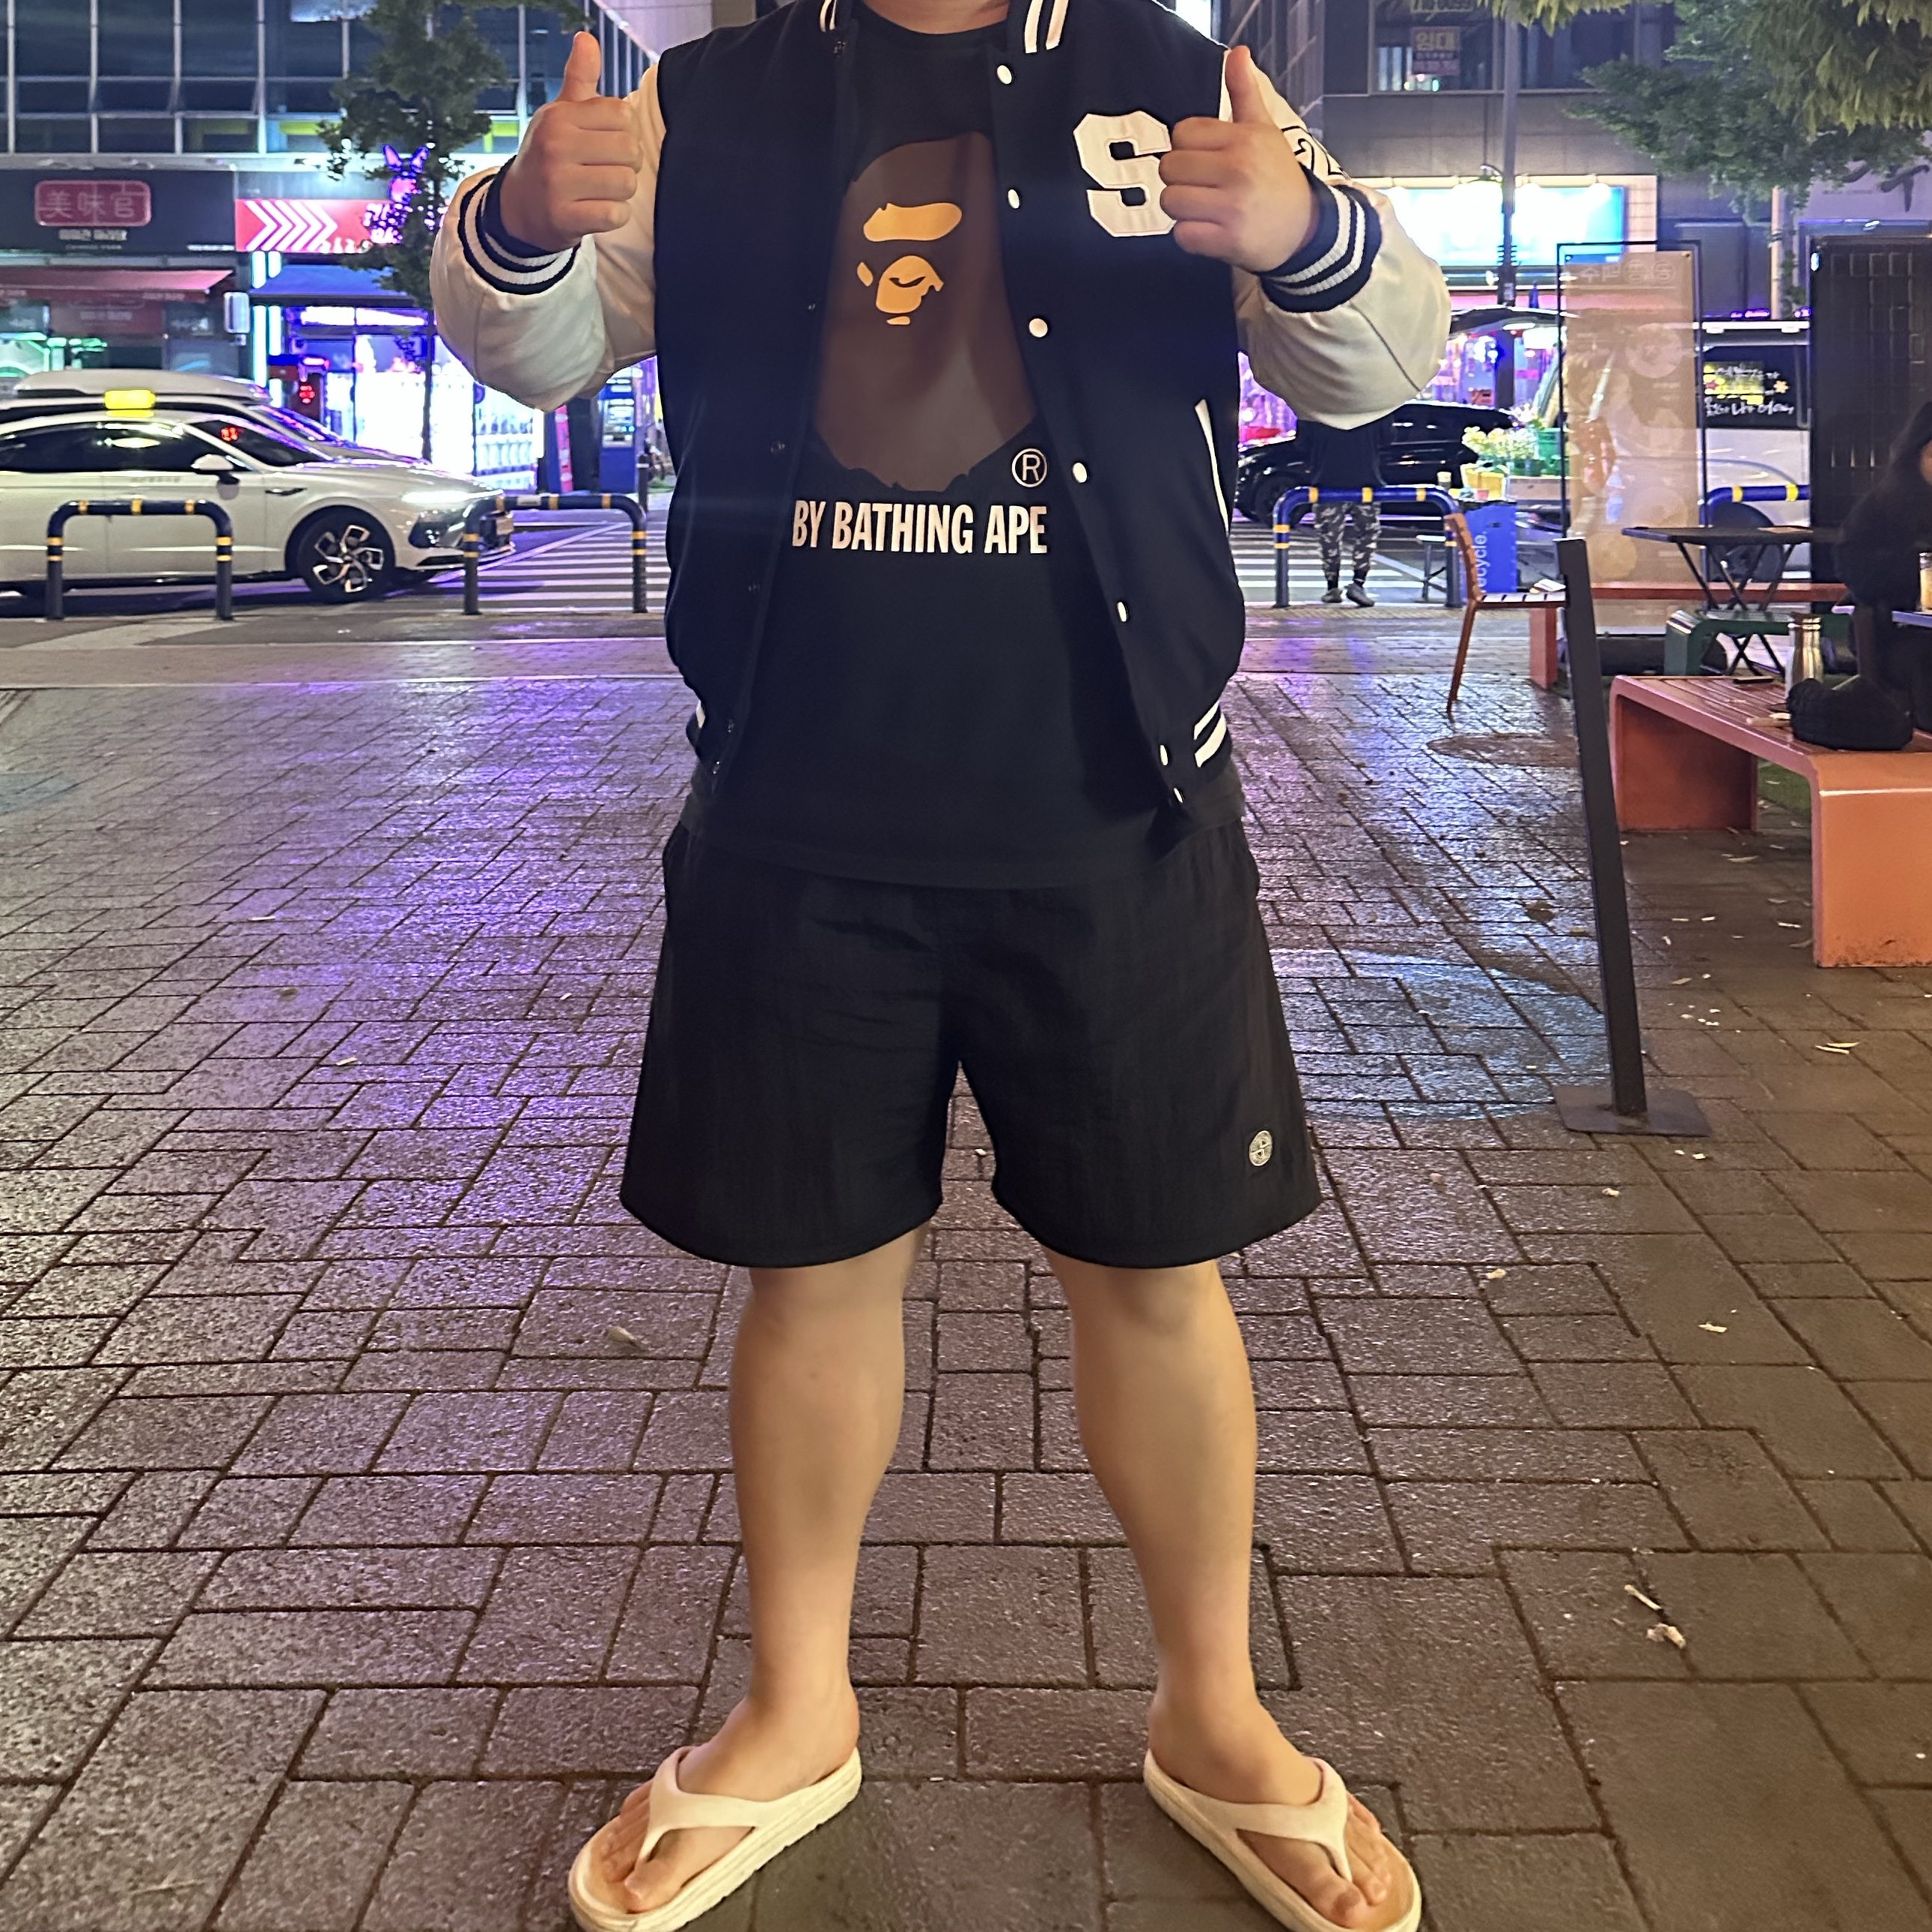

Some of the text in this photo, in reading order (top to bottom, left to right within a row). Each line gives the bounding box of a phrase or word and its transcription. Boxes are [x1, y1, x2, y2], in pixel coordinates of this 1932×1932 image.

[1073, 110, 1177, 237] S
[792, 500, 1047, 554] BY BATHING APE
